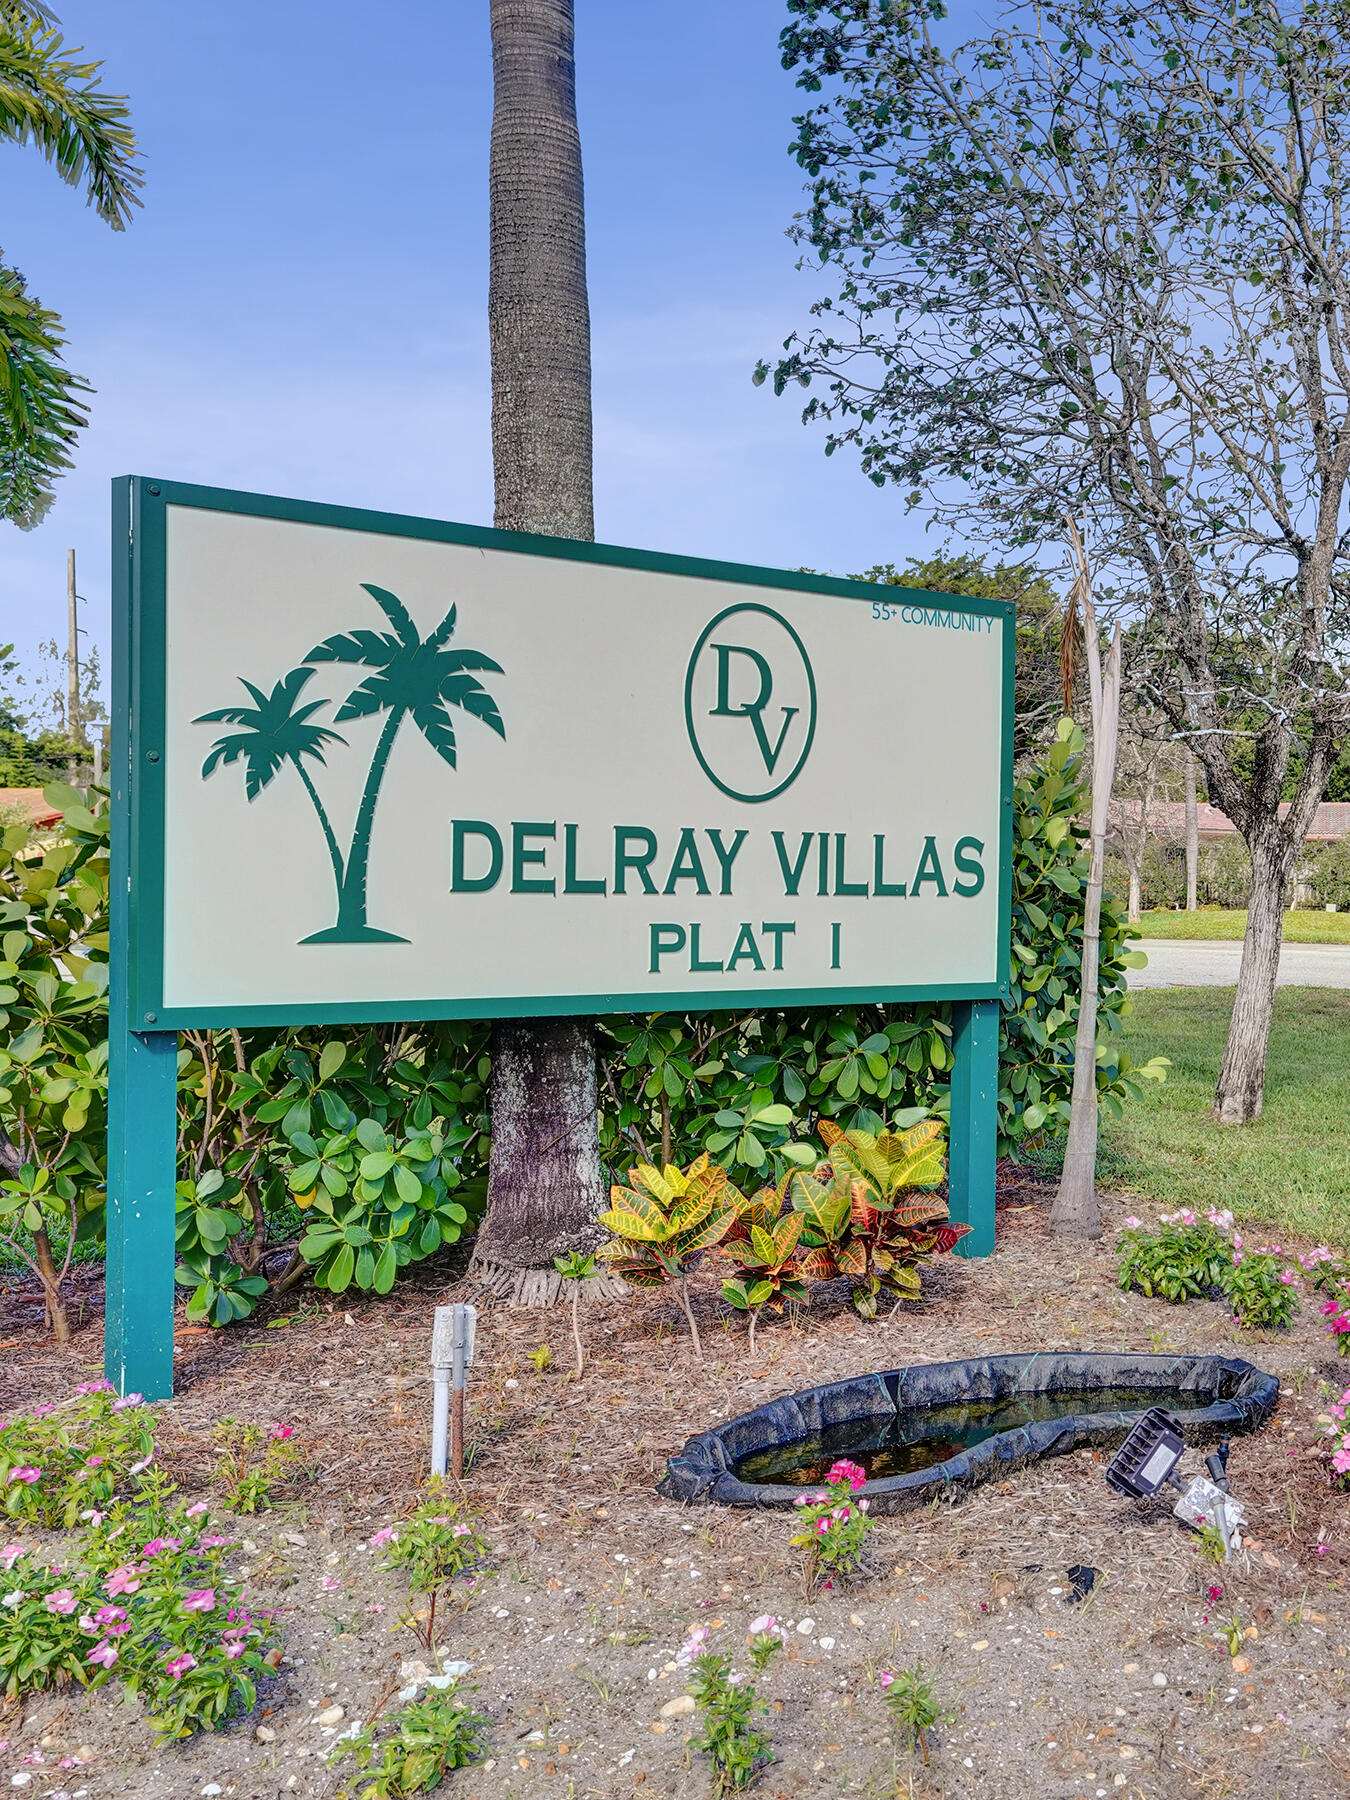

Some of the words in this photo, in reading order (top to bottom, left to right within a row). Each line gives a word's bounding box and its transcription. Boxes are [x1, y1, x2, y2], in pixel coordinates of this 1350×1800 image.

[872, 602, 897, 620] 55+
[901, 606, 994, 633] COMMUNITY
[449, 819, 750, 898] DELRAY
[770, 830, 986, 900] VILLAS
[648, 920, 797, 974] PLAT
